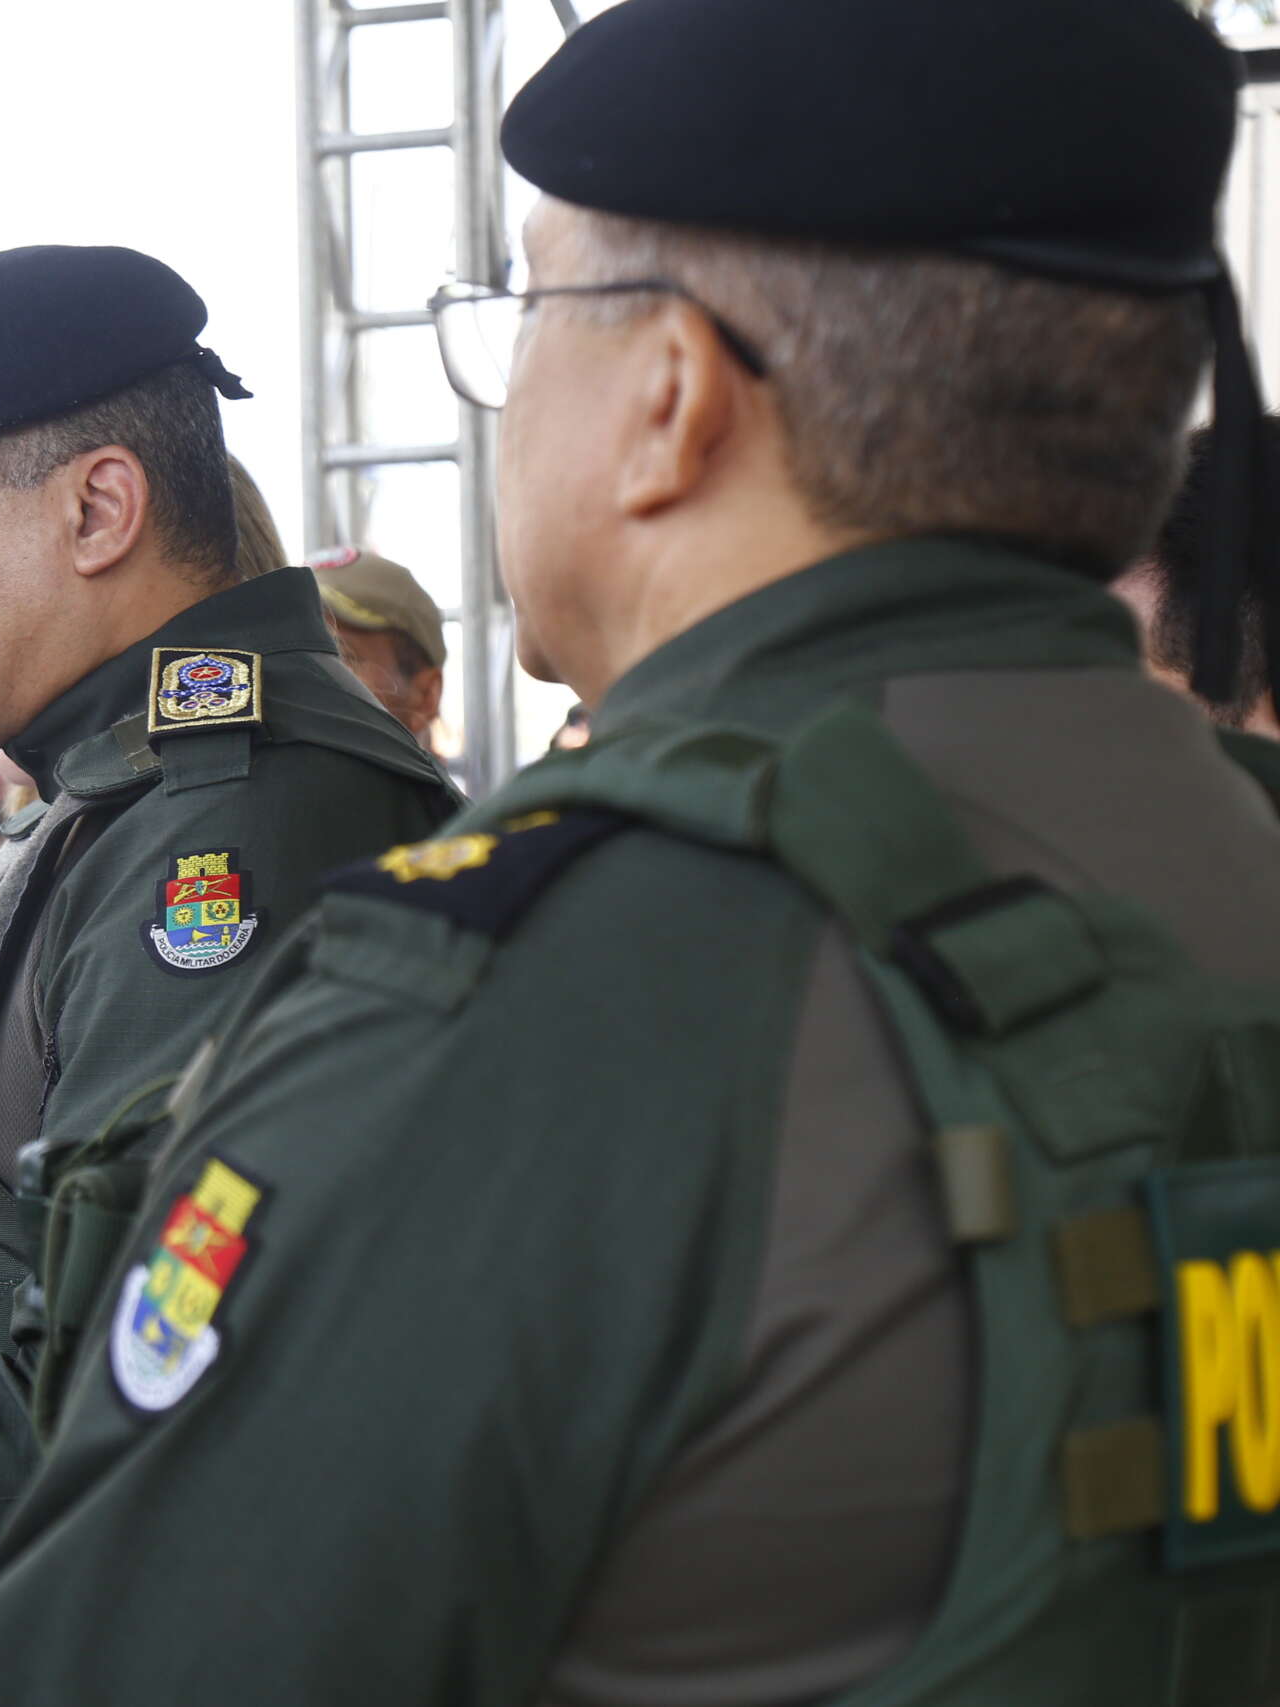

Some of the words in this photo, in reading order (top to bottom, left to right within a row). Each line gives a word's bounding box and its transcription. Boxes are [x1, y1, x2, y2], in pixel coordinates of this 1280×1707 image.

[180, 957, 216, 967] MILITAR
[216, 951, 230, 963] DO
[1175, 1249, 1280, 1522] PO
